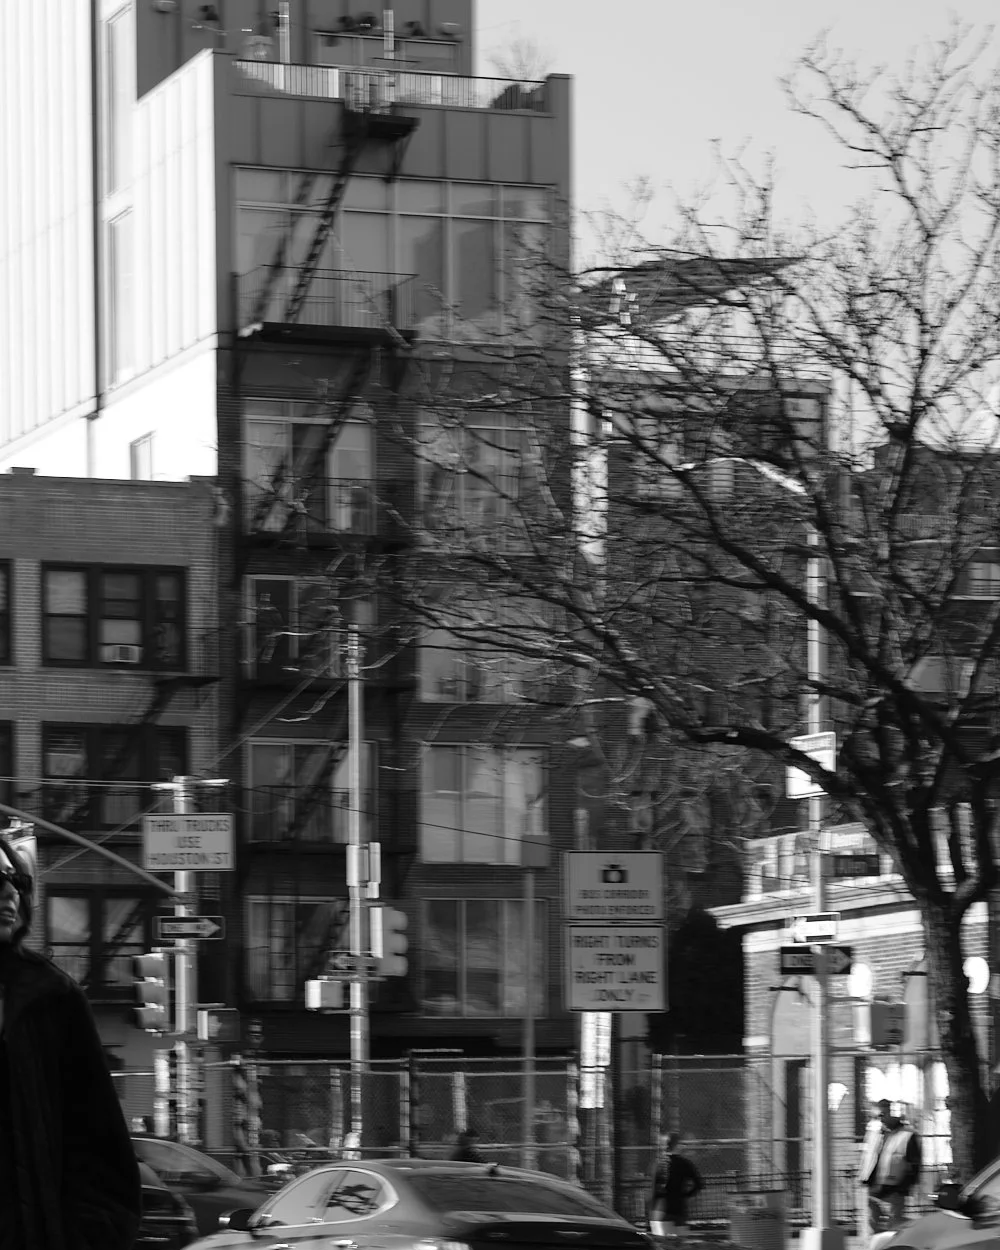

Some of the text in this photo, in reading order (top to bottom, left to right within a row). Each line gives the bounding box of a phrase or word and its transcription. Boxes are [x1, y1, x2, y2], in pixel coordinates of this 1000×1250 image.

[148, 819, 230, 832] THRU TRUCKS
[175, 836, 203, 848] USE
[148, 853, 229, 865] HOUSTON ST
[573, 936, 660, 948] RIGHT TURNS
[594, 953, 635, 966] FROM
[574, 971, 658, 983] RIGHT LANE
[592, 989, 635, 1001] ONLY
